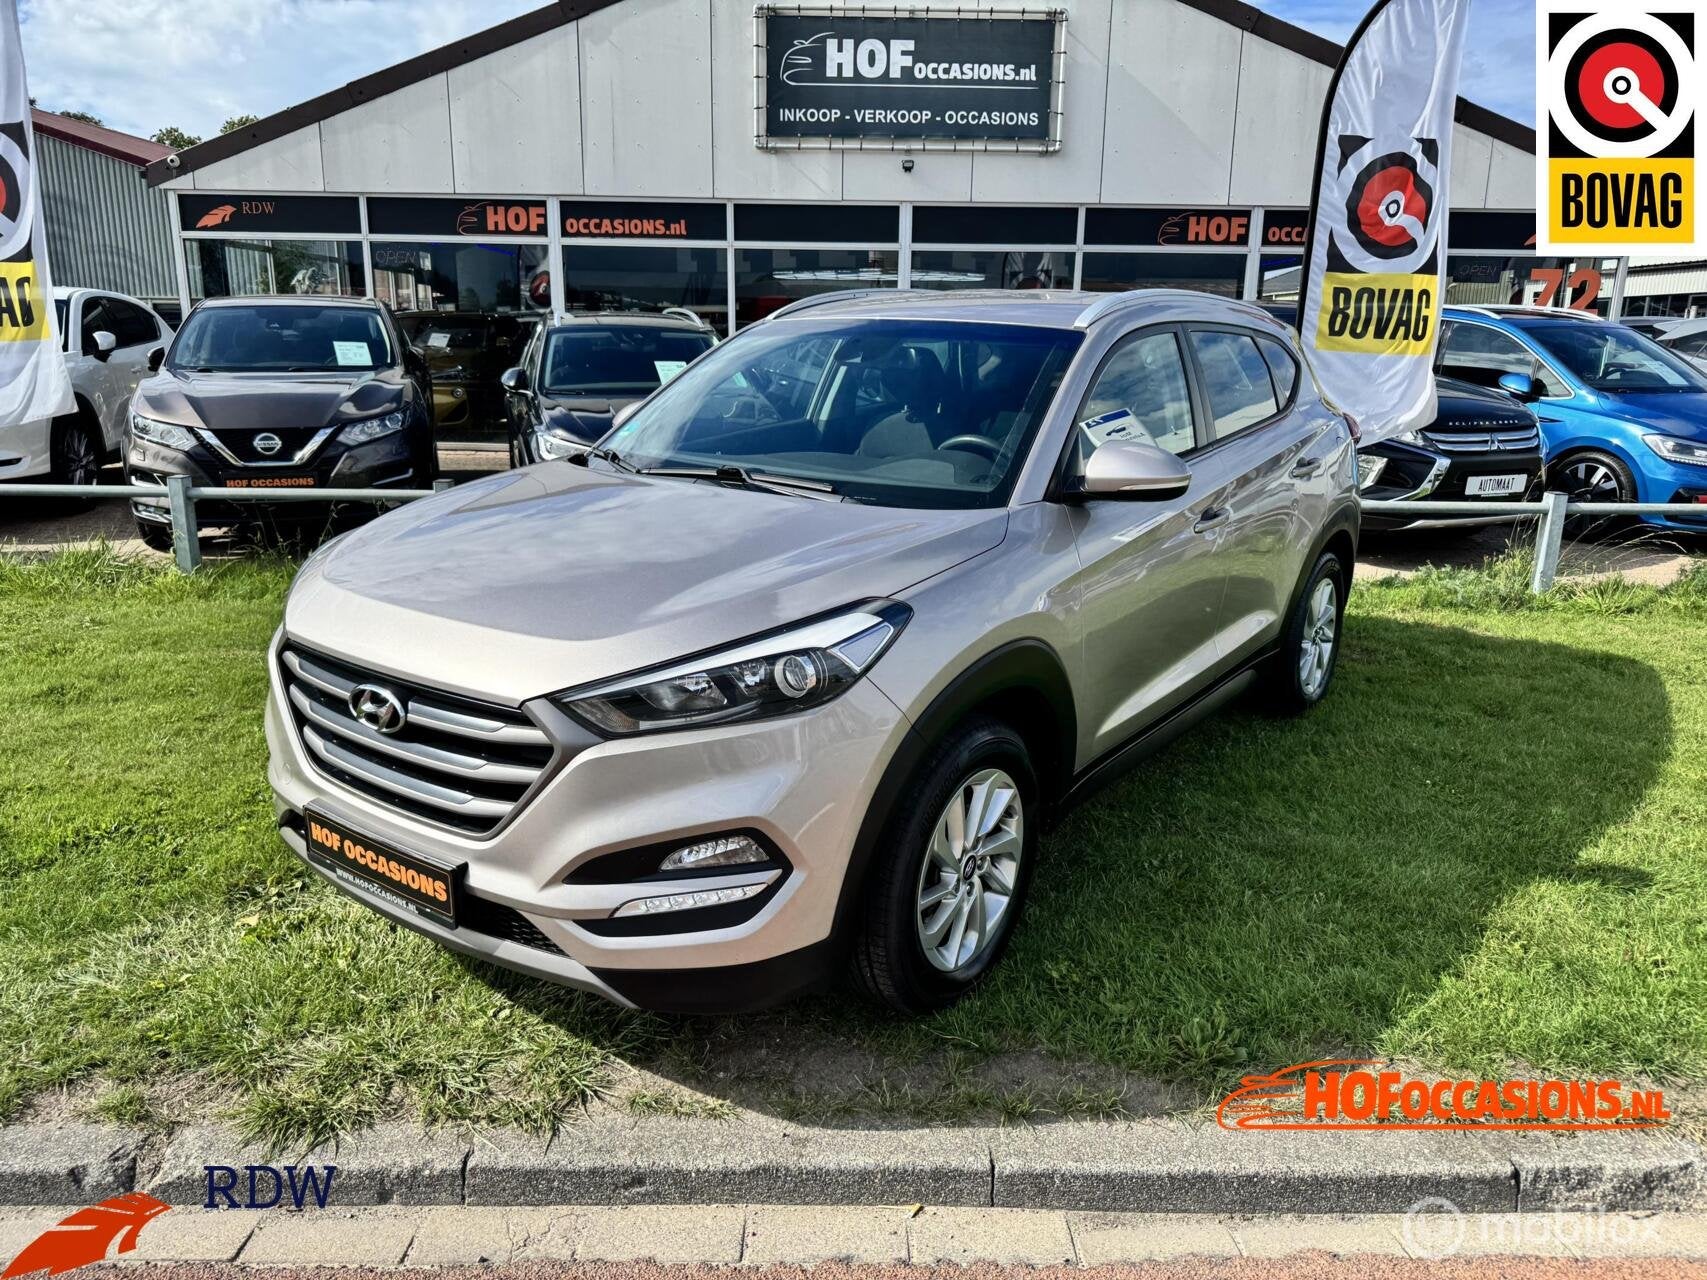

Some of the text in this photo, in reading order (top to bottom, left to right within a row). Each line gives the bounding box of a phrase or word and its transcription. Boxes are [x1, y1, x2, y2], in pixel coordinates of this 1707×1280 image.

[779, 108, 841, 122] INKOOP
[854, 109, 932, 124] VERKOOP
[945, 111, 1039, 125] OCCASIONS
[242, 201, 275, 214] RDW
[486, 206, 687, 236] HOF OCCASIONS.nl
[1187, 216, 1248, 242] HOF
[1460, 264, 1496, 277] OPEN
[1530, 268, 1601, 314] 72
[1328, 286, 1431, 341] BOVAG
[251, 478, 314, 487] OCCASIONS
[1479, 478, 1515, 491] AUTOMAAT
[311, 821, 448, 902] HOF OCCASIONS
